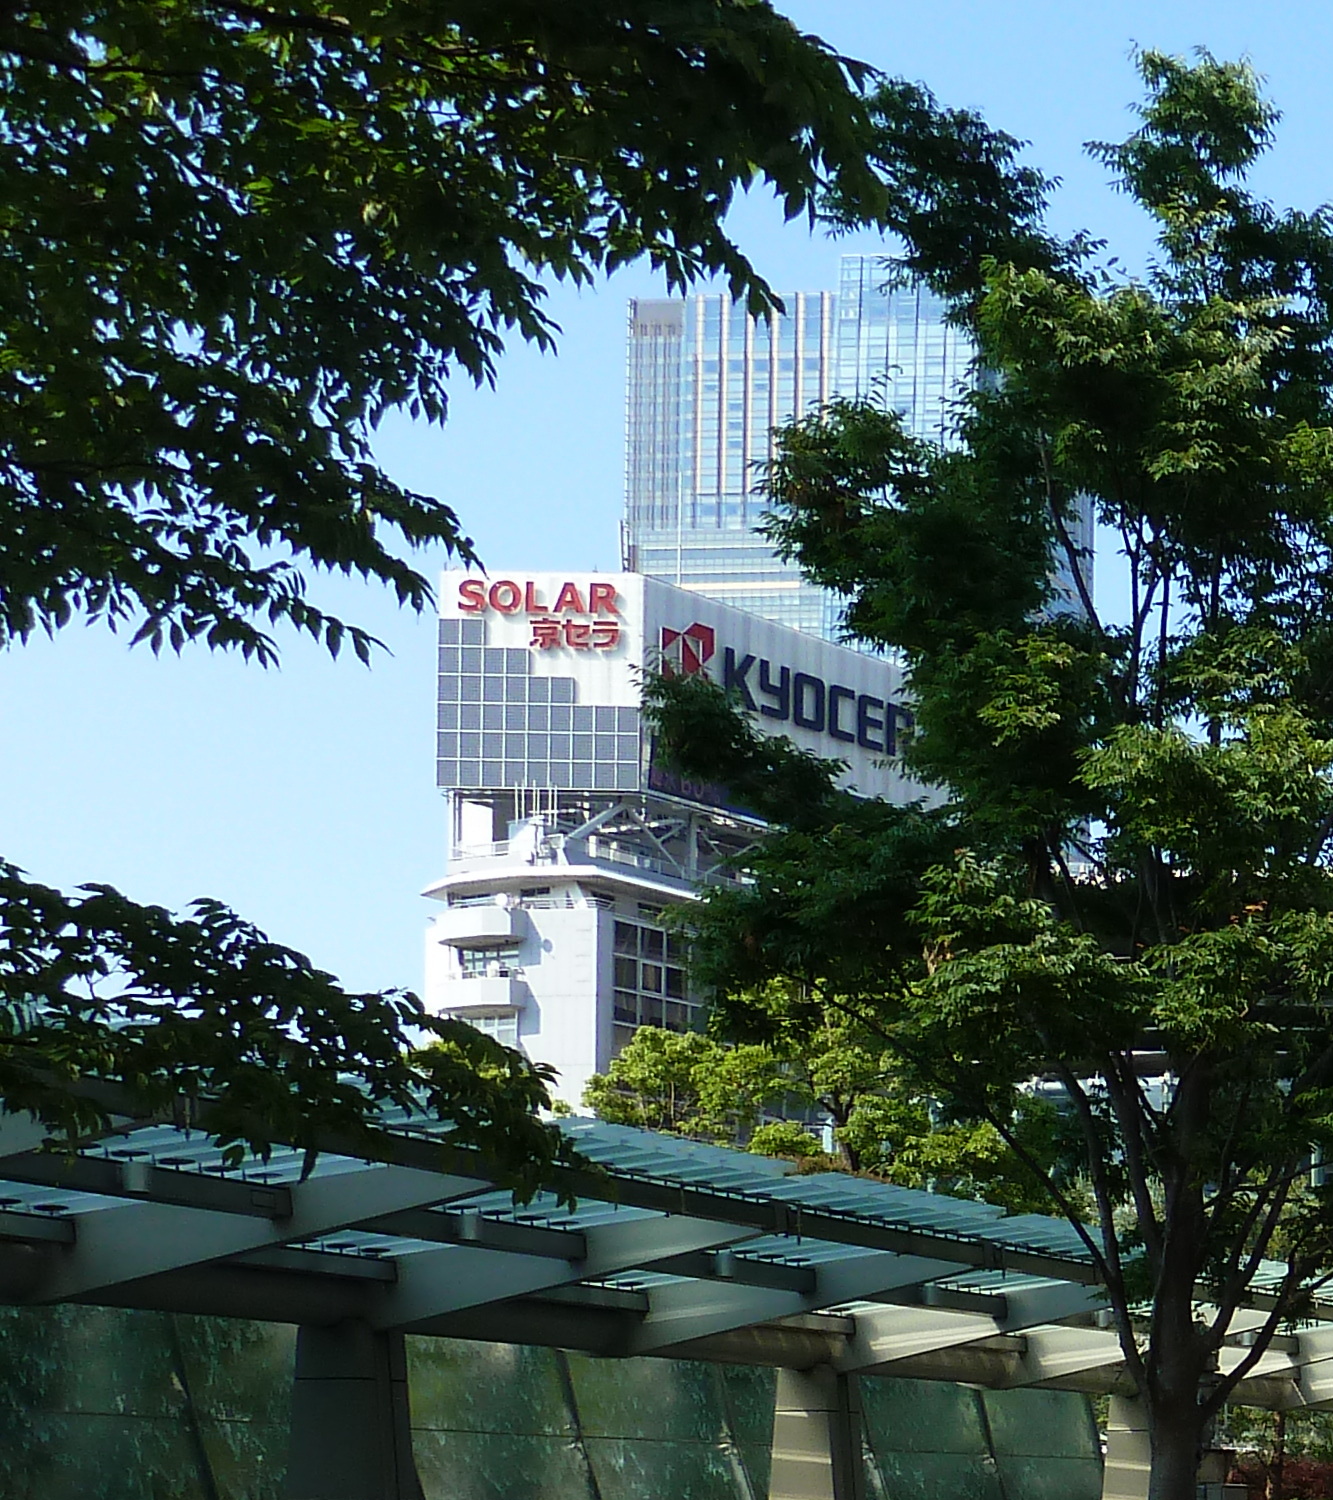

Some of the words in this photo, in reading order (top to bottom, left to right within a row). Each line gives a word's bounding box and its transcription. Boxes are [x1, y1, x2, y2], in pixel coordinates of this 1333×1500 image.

[458, 579, 619, 614] SOLAR
[529, 618, 619, 650] 京セラ
[724, 646, 916, 757] KYOCER
